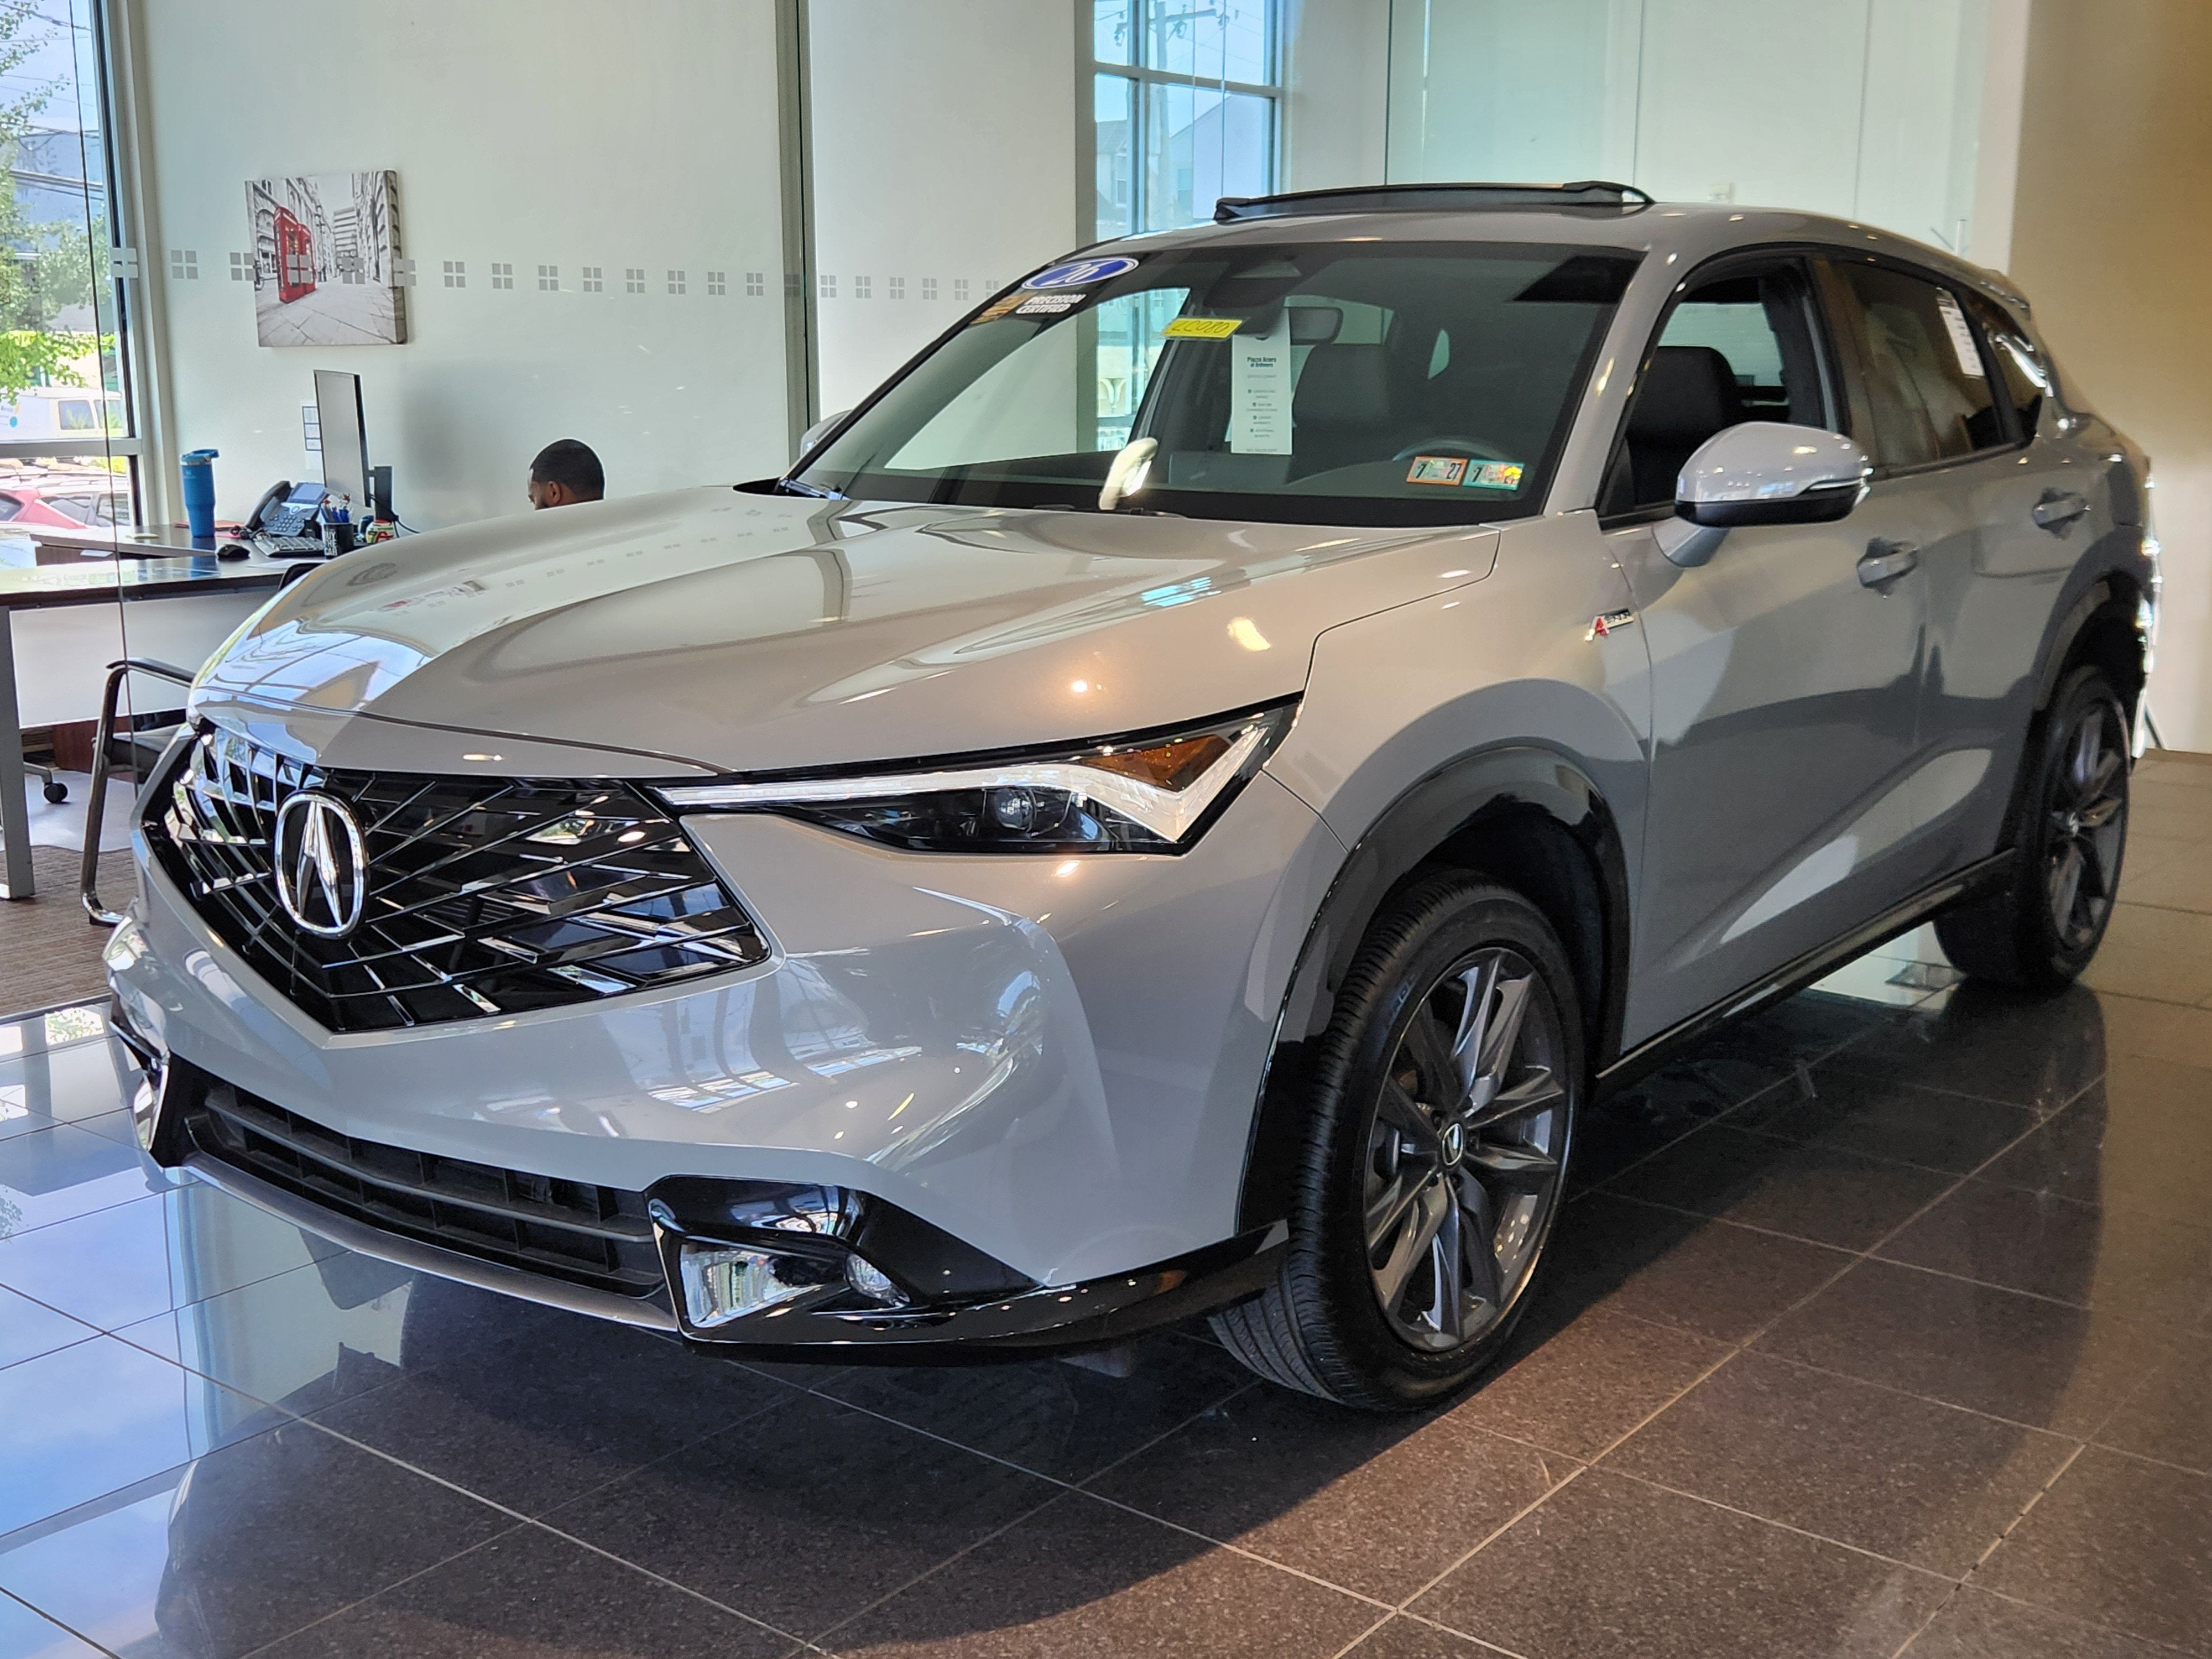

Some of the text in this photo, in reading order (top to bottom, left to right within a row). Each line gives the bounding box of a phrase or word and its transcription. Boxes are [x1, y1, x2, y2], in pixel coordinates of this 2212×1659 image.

[1040, 260, 1120, 286] 26
[1025, 294, 1087, 305] PRECISION
[1015, 303, 1071, 314] CERTIFIED
[1446, 462, 1463, 481] 27
